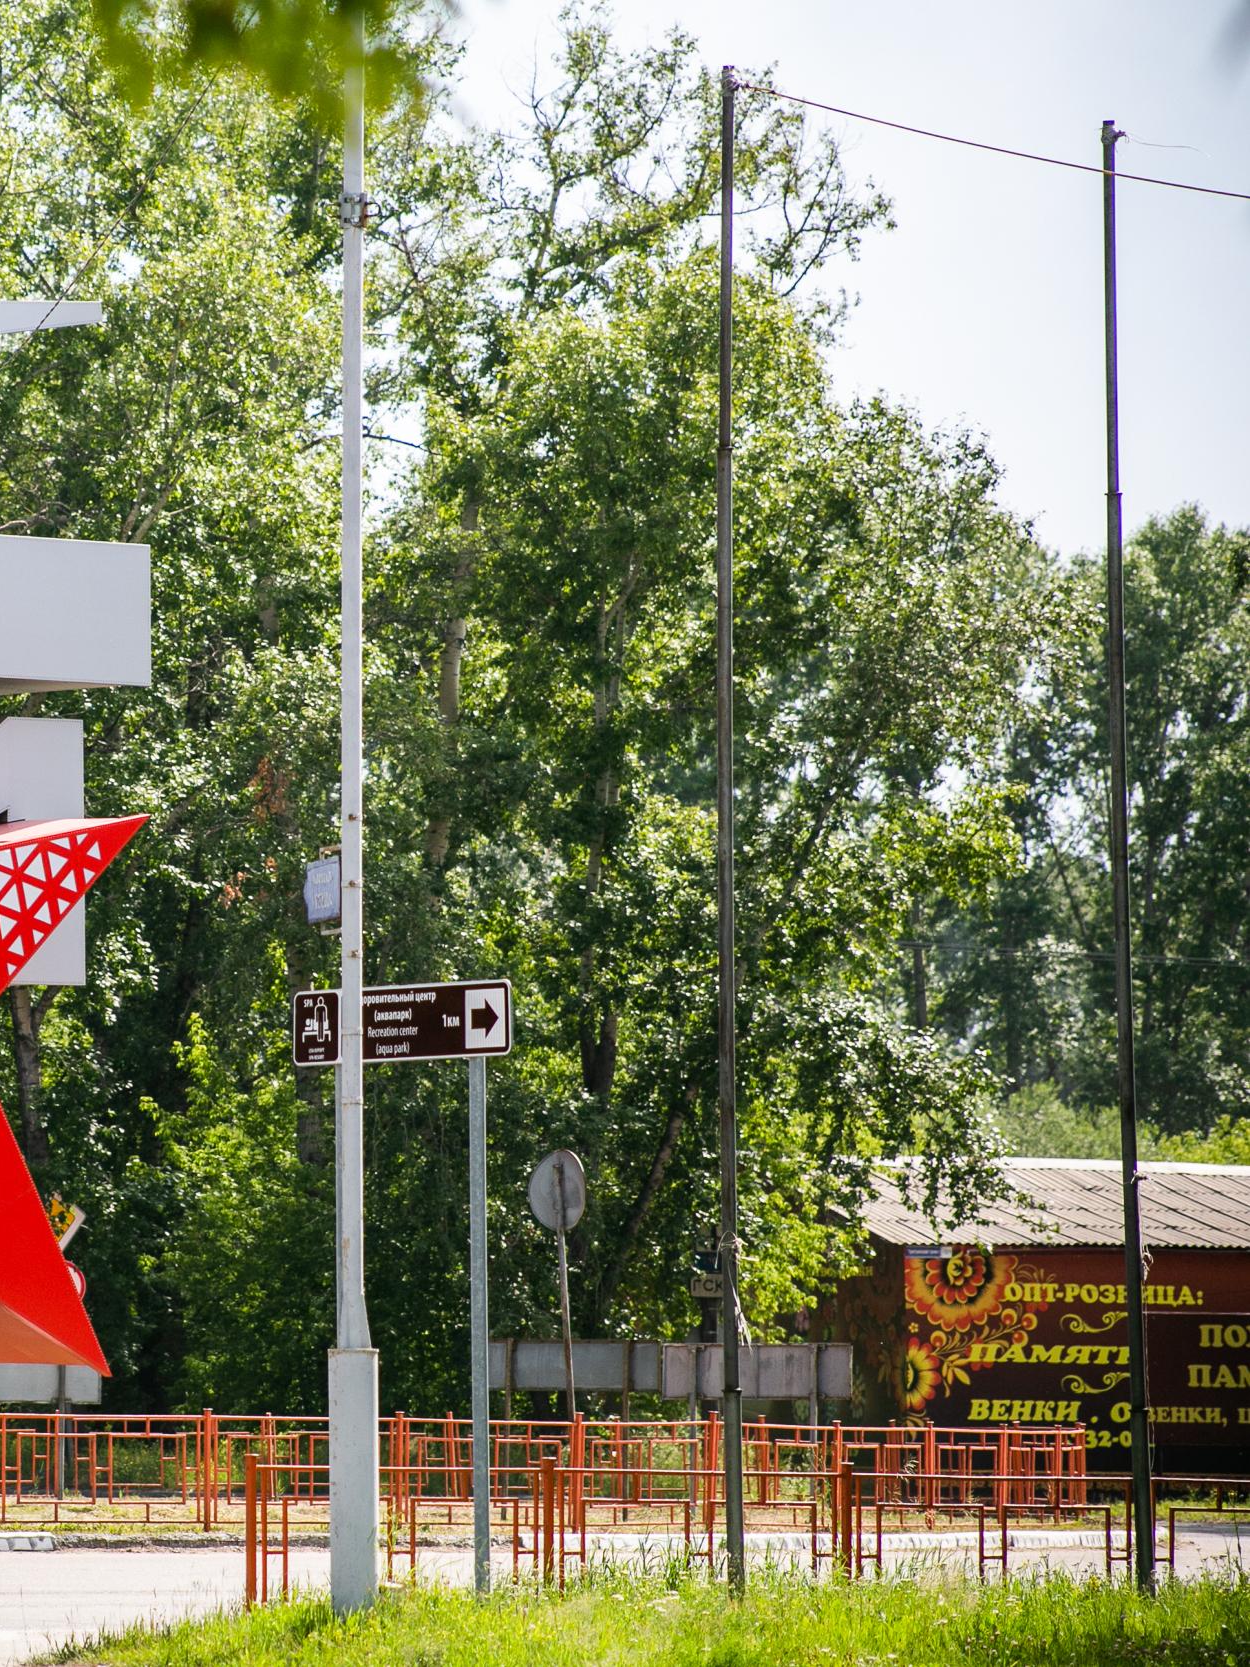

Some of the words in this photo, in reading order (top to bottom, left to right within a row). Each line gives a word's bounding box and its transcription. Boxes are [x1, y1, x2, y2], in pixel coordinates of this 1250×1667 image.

[362, 990, 414, 1007] оровительный
[415, 991, 436, 1004] центр
[374, 1008, 412, 1022] (аквапарк)
[367, 1026, 399, 1038] Recreation
[399, 1025, 418, 1036] center
[375, 1043, 393, 1057] (aqua
[393, 1041, 410, 1056] park)
[1199, 1324, 1250, 1348] ПО
